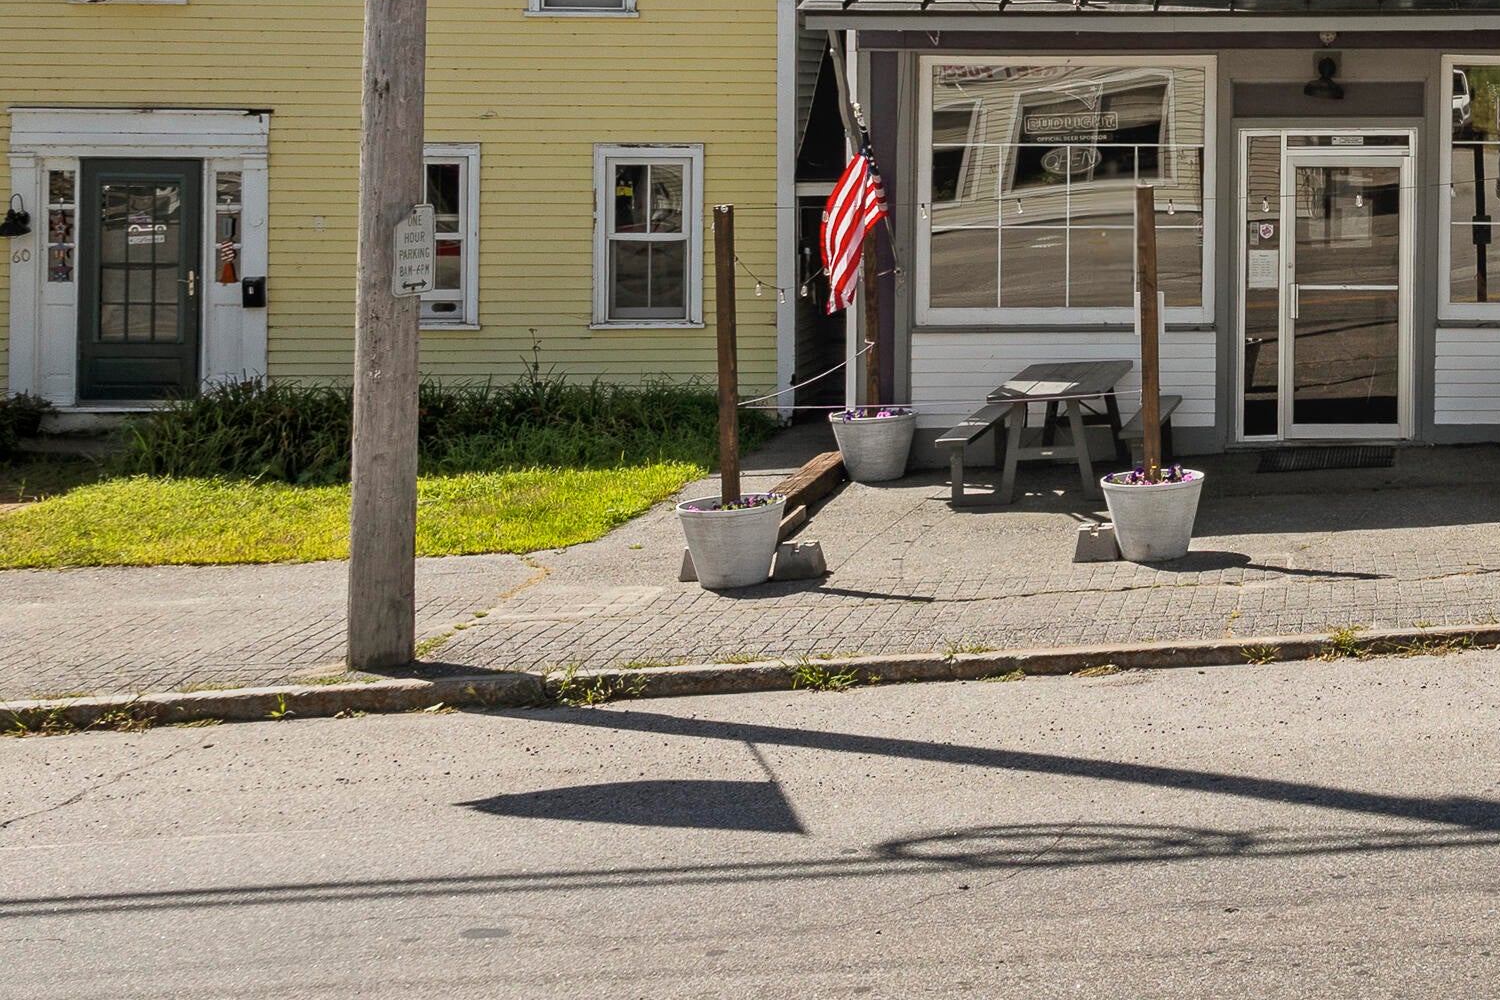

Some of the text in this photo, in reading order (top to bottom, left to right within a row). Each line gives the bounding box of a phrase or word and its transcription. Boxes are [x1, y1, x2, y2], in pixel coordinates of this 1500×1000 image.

[1027, 117, 1063, 131] BUD
[1036, 133, 1108, 143] OFFICIAL BEER SPONSOR
[1045, 151, 1096, 168] OPEN
[408, 215, 422, 227] ONE
[404, 231, 426, 244] HOUR
[12, 248, 31, 264] 60
[400, 247, 430, 261] PARKING
